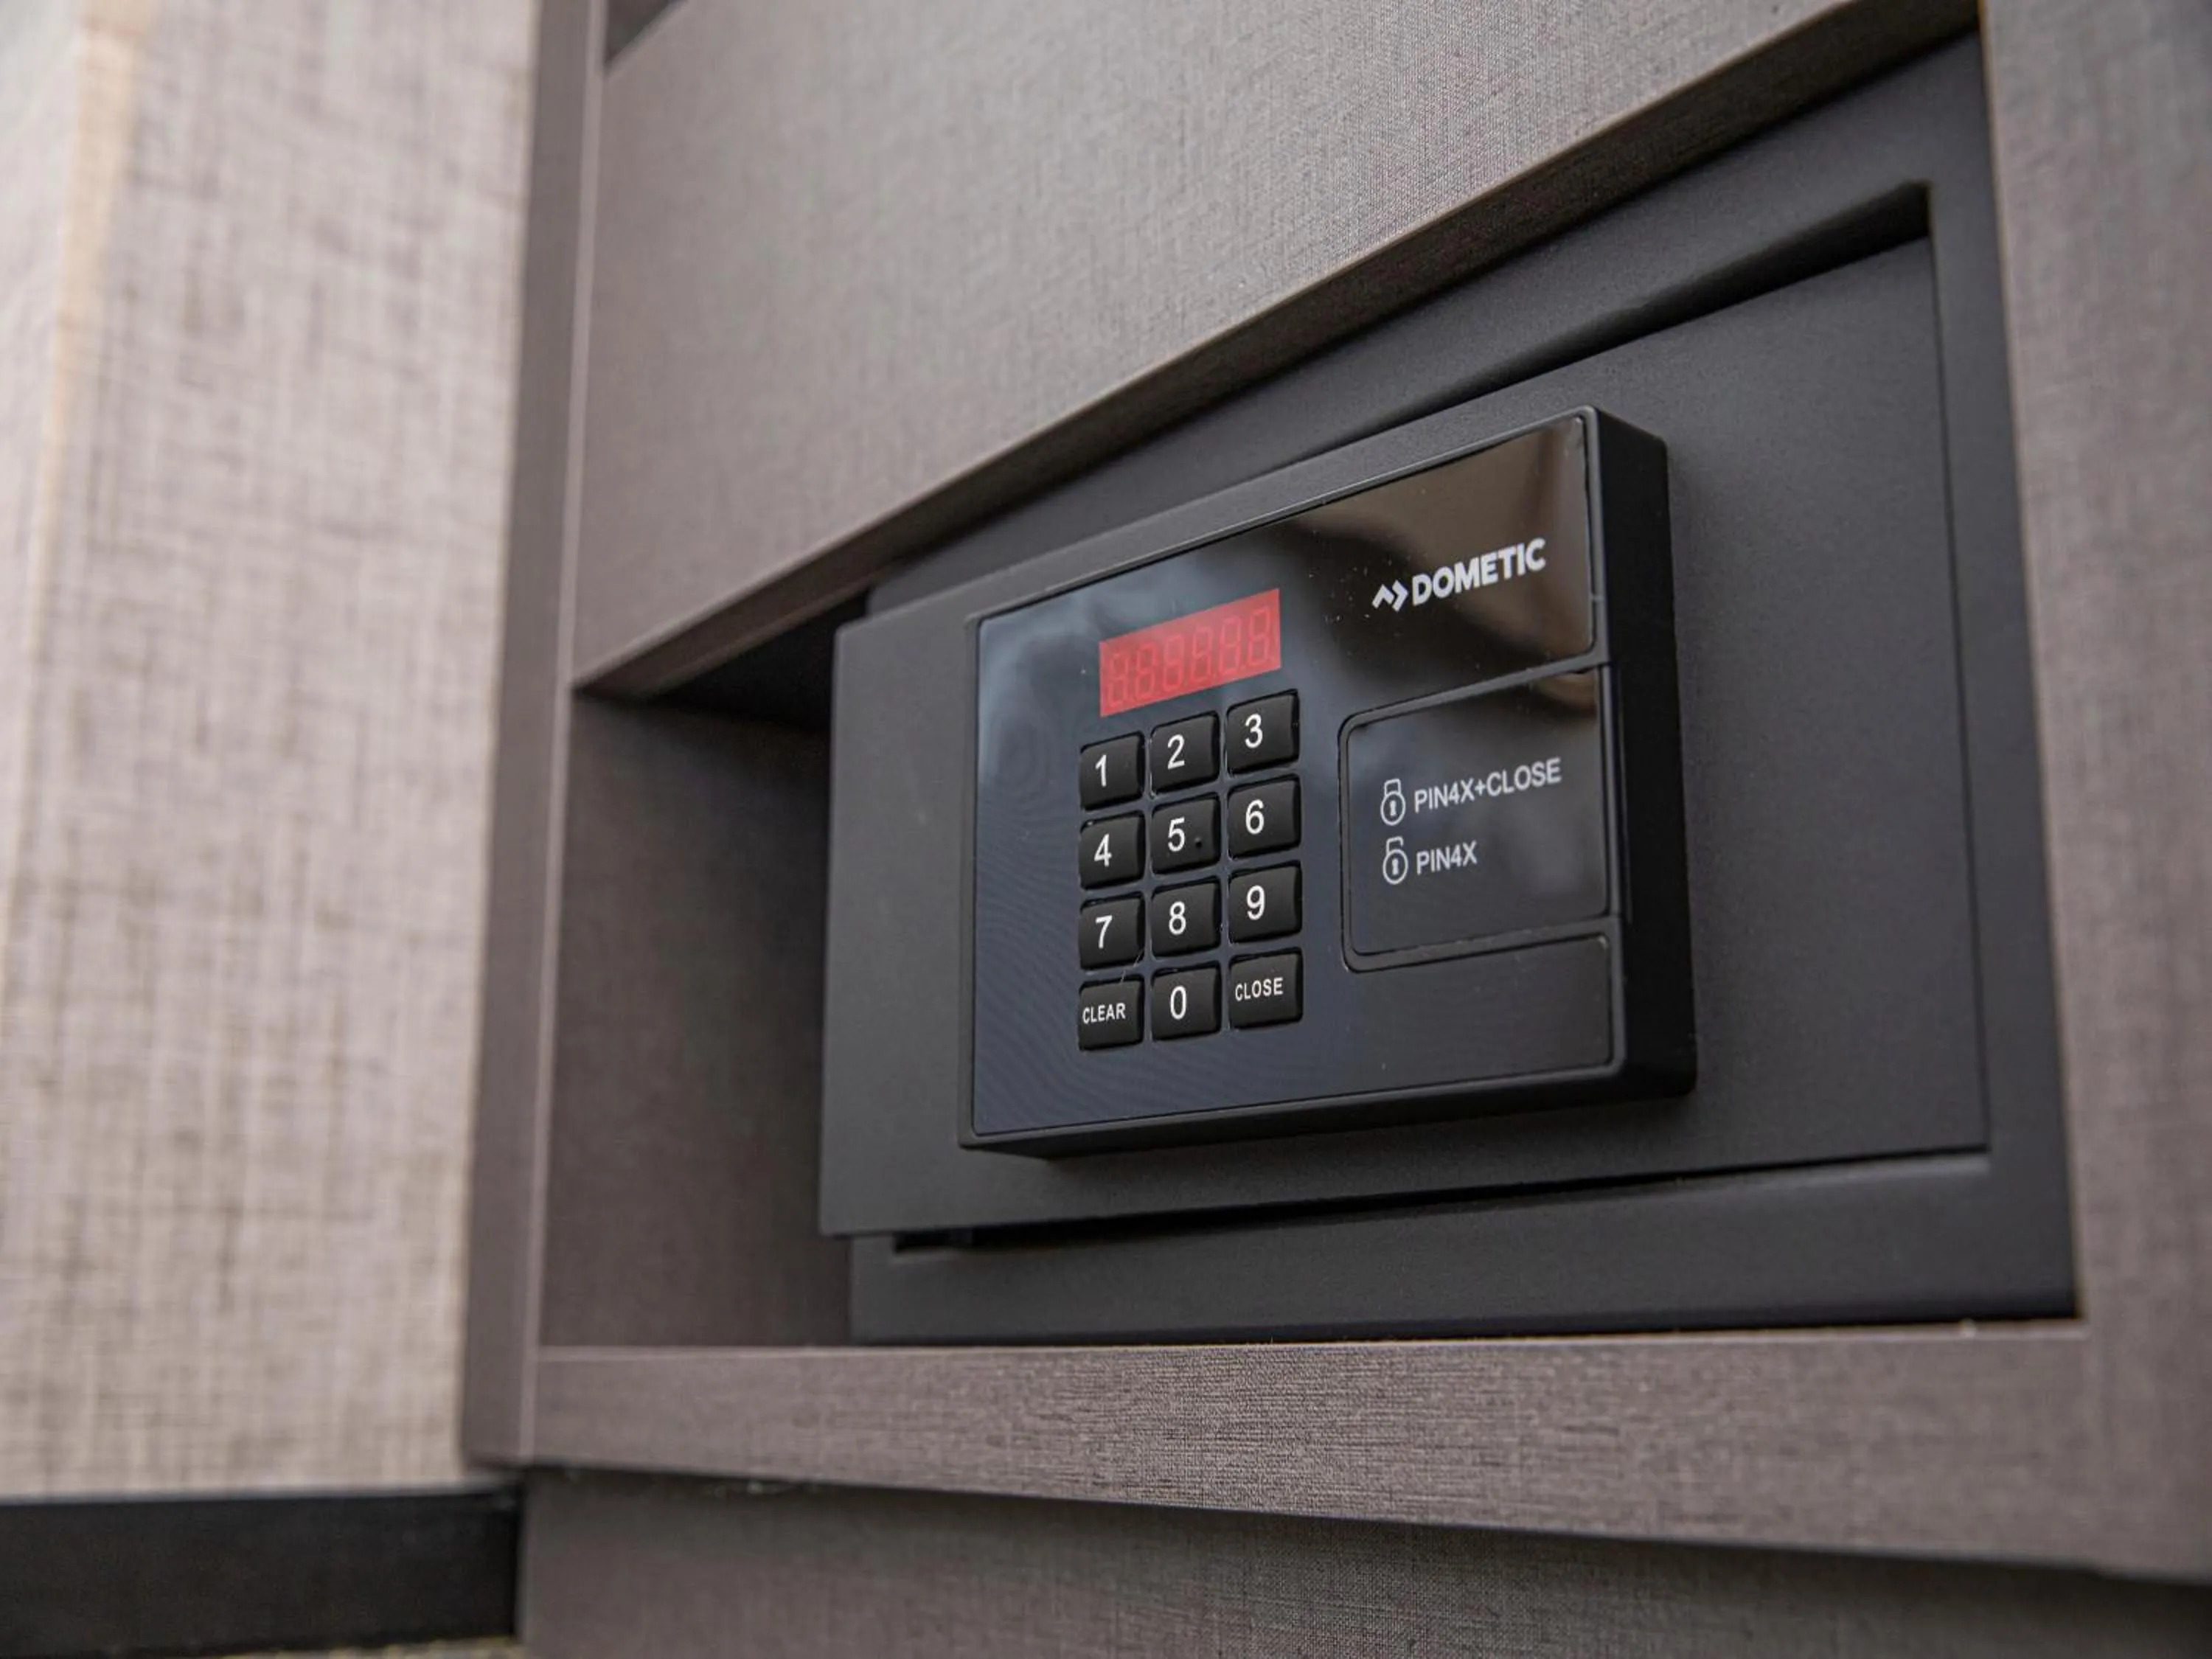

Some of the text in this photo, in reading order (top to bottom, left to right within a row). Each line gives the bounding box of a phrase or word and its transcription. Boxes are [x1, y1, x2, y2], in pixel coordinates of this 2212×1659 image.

[1411, 538, 1546, 605] DOMETIC
[1245, 713, 1263, 748] 3
[1167, 734, 1185, 769] 2
[1095, 754, 1107, 787] 1
[1414, 758, 1561, 813] PIN4X+CLOSE
[1168, 817, 1185, 852] 5
[1245, 799, 1265, 835] 6
[1094, 833, 1112, 866] 4
[1416, 841, 1478, 875] PIN4X
[1169, 901, 1186, 935] 8
[1246, 885, 1265, 920] 9
[1095, 915, 1113, 948] 7
[1170, 985, 1187, 1020] 0
[1235, 977, 1283, 1001] CLOSE
[1082, 1002, 1126, 1024] CLEAR
